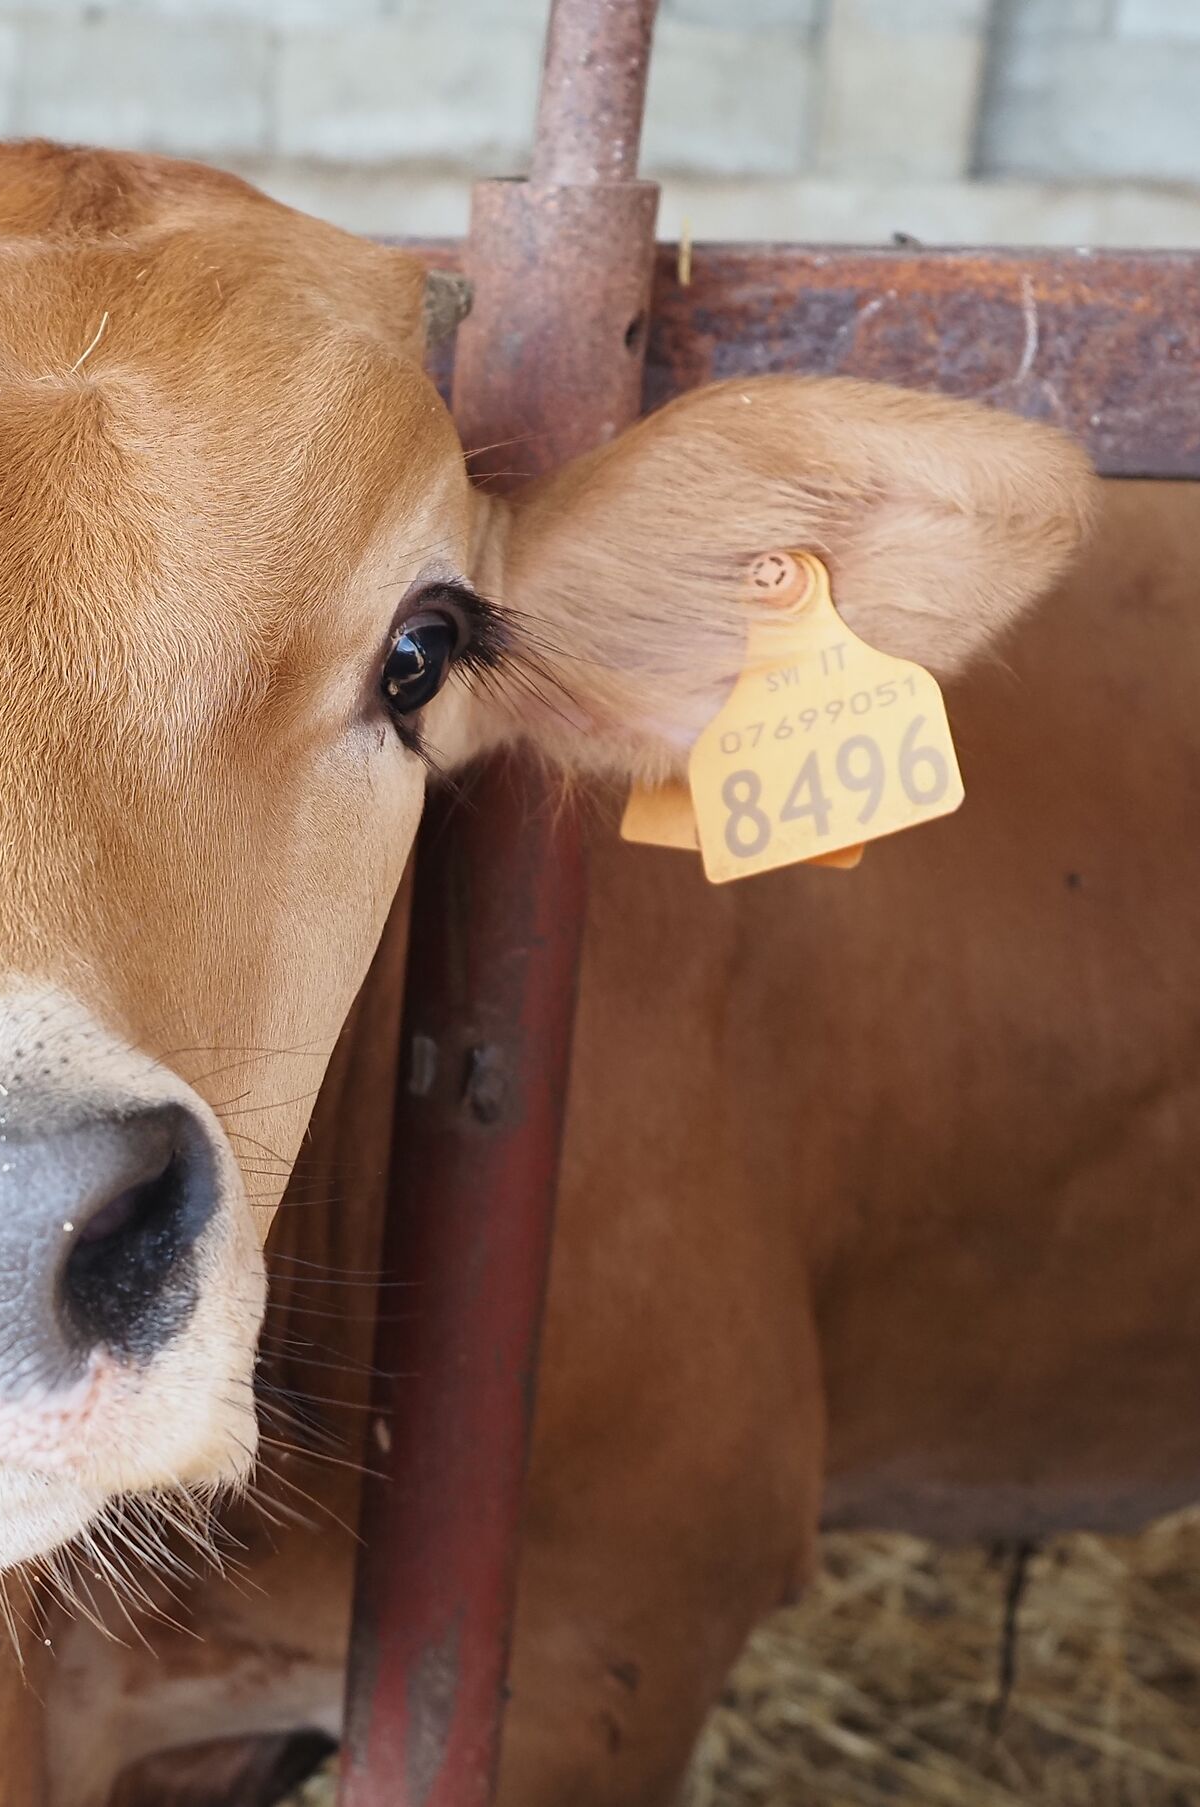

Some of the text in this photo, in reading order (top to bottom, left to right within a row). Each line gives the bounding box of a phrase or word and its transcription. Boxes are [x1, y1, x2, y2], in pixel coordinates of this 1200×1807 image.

[819, 642, 848, 677] IT
[719, 676, 916, 755] 07699051
[721, 714, 949, 859] 8496
